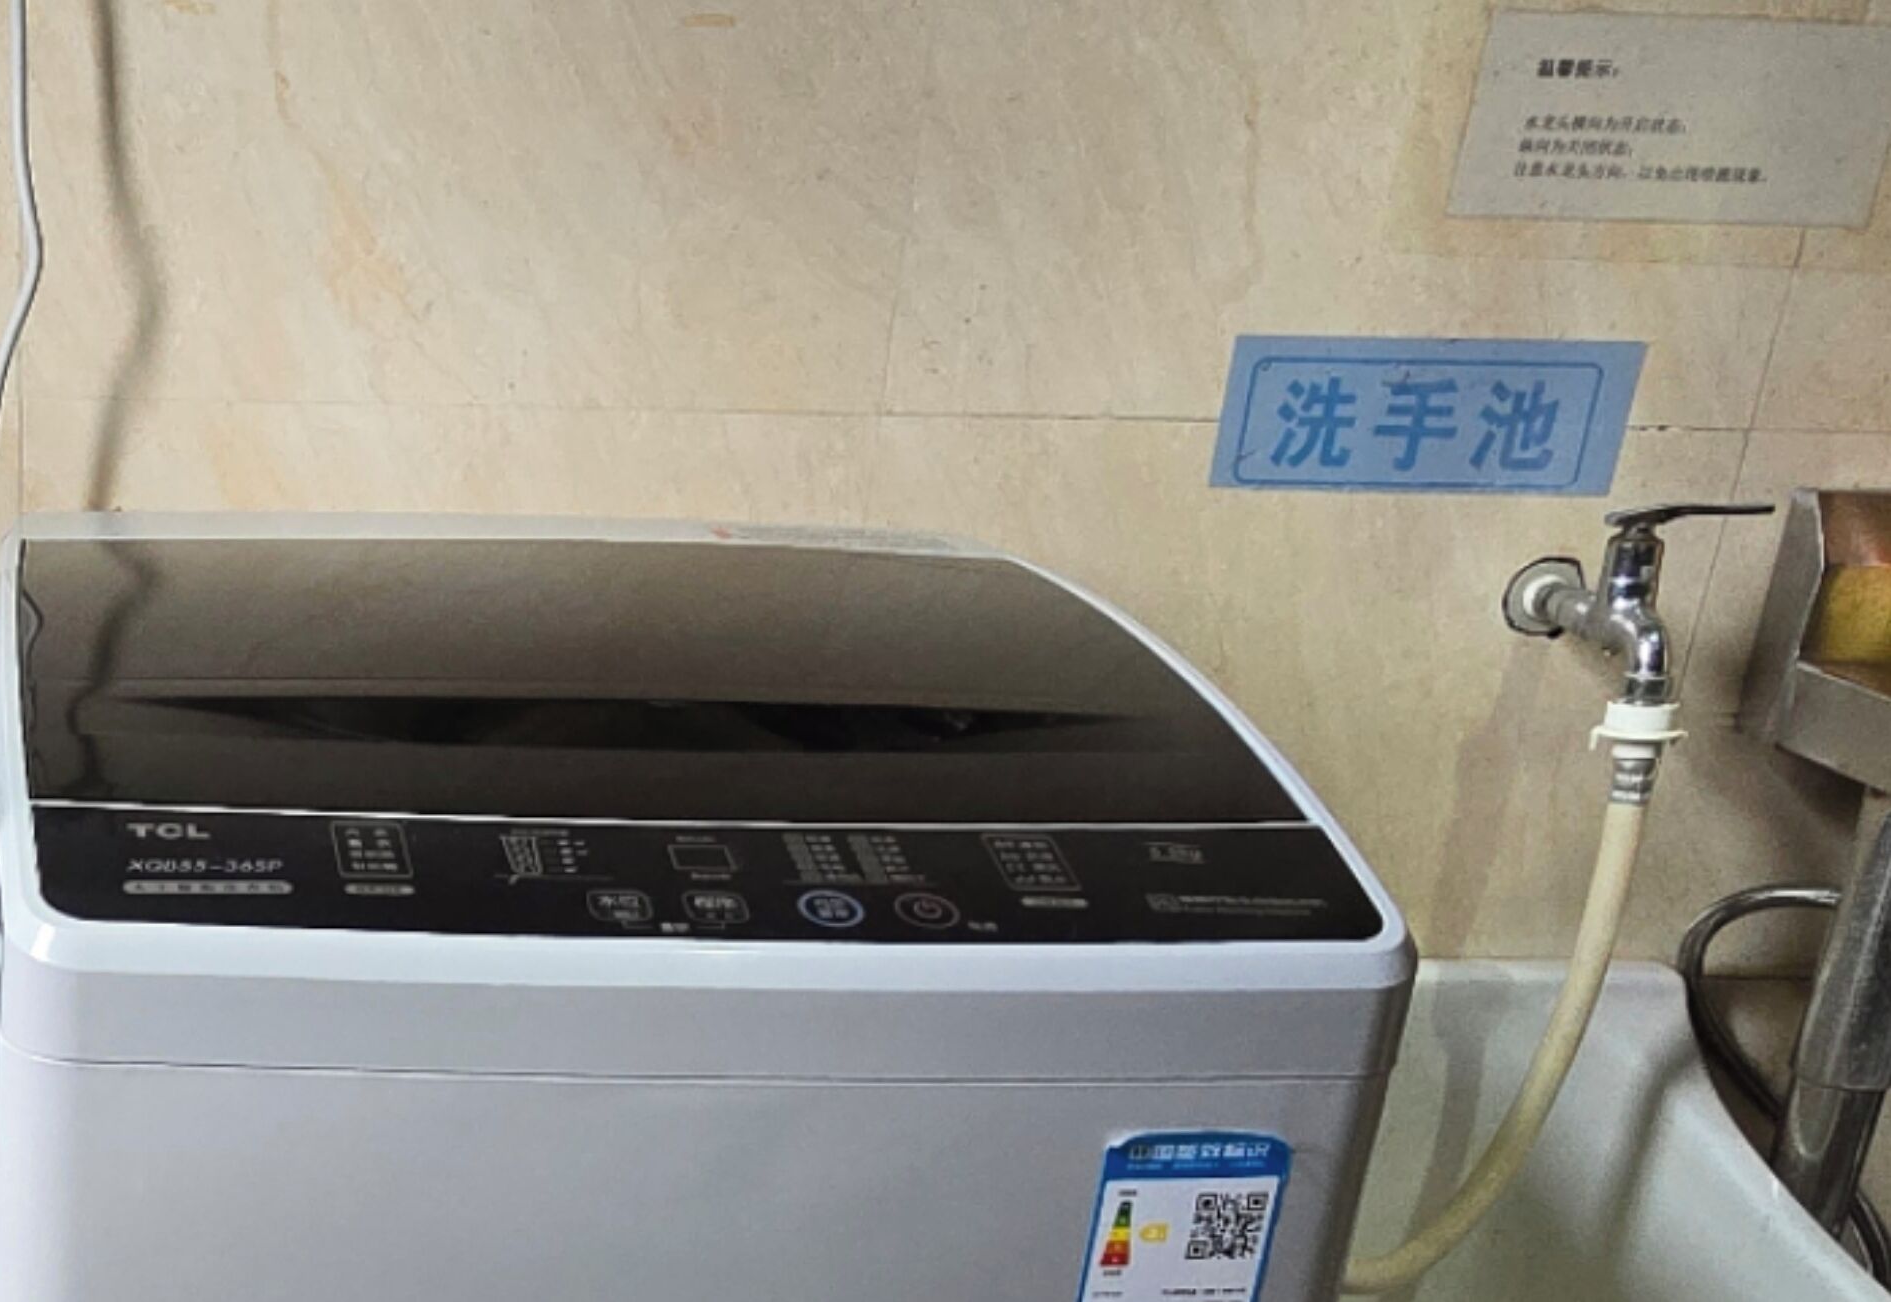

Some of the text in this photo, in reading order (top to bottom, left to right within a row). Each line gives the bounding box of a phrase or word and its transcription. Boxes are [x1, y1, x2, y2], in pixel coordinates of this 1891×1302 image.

[1270, 376, 1560, 472] 洗手池
[125, 821, 212, 841] TCL
